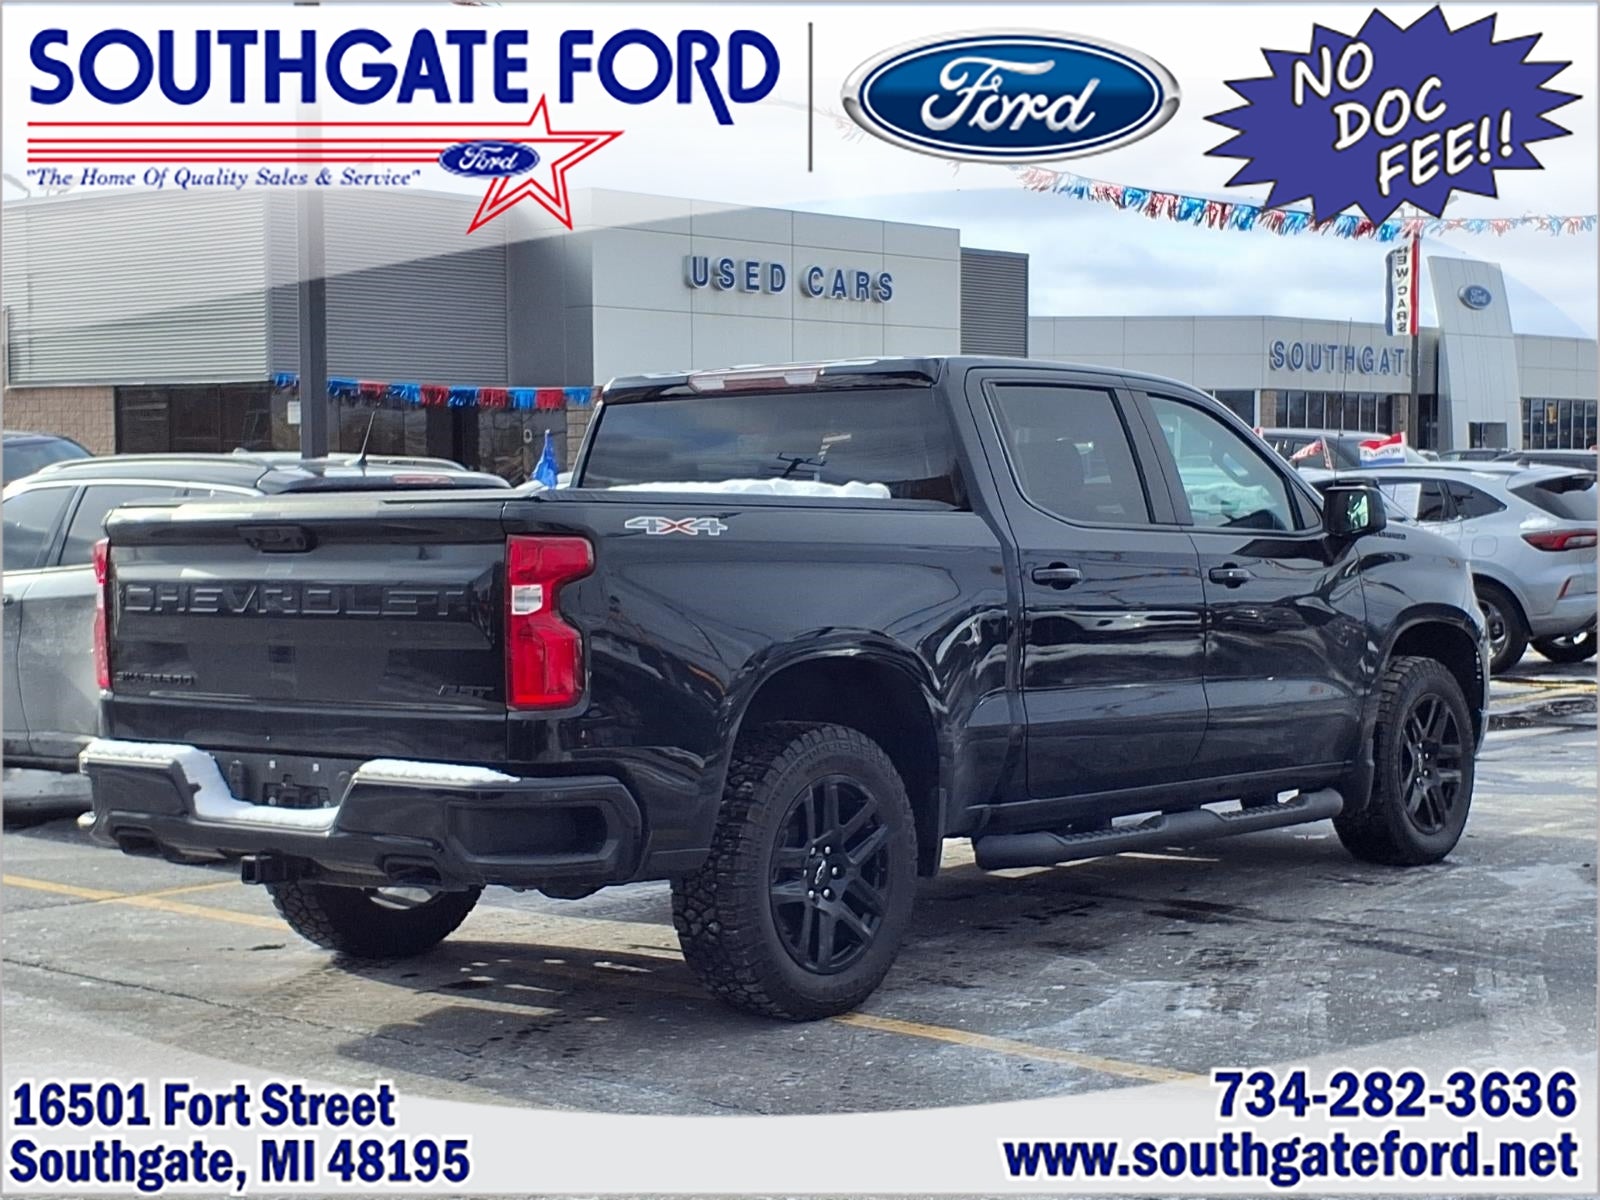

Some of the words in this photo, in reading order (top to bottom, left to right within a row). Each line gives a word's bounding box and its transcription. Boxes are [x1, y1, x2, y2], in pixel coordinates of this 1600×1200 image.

[685, 255, 786, 293] USED
[803, 265, 893, 301] CARS
[1271, 339, 1413, 377] SOUTHGAT
[123, 583, 465, 617] CHEVROLET
